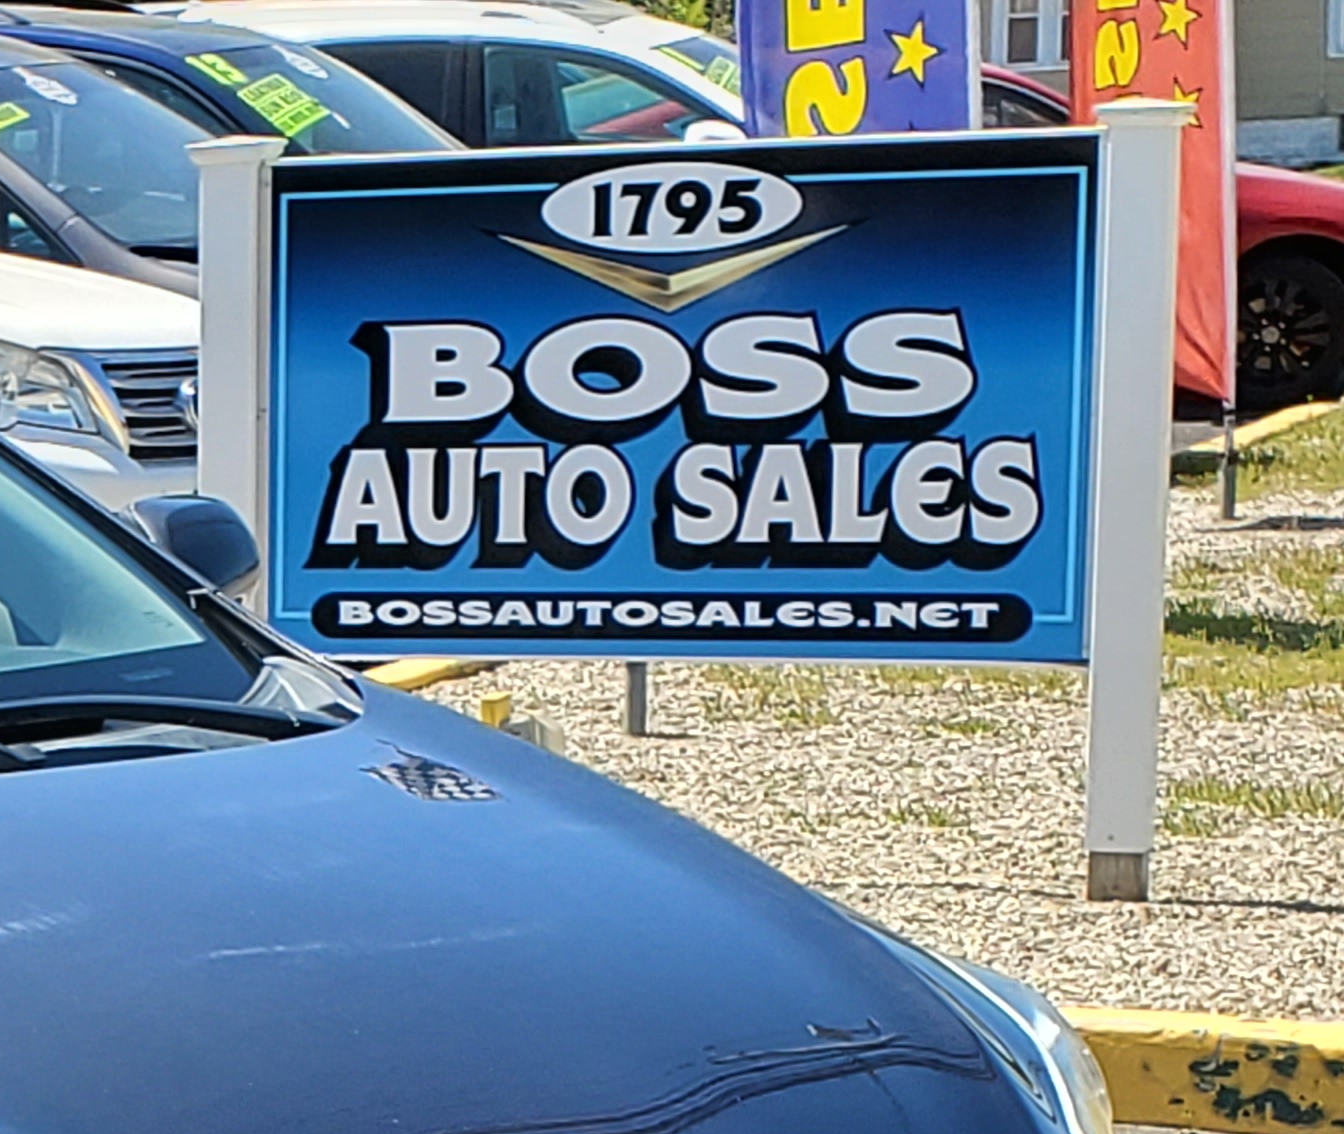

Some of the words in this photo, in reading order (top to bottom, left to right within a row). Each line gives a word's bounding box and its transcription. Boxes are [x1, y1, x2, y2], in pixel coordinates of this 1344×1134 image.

[591, 177, 763, 237] 1795
[377, 310, 976, 424] BOSS
[324, 443, 635, 548] AUTO
[670, 437, 1041, 547] SALES
[337, 600, 1000, 631] BOSSAUTOSALES.NET
